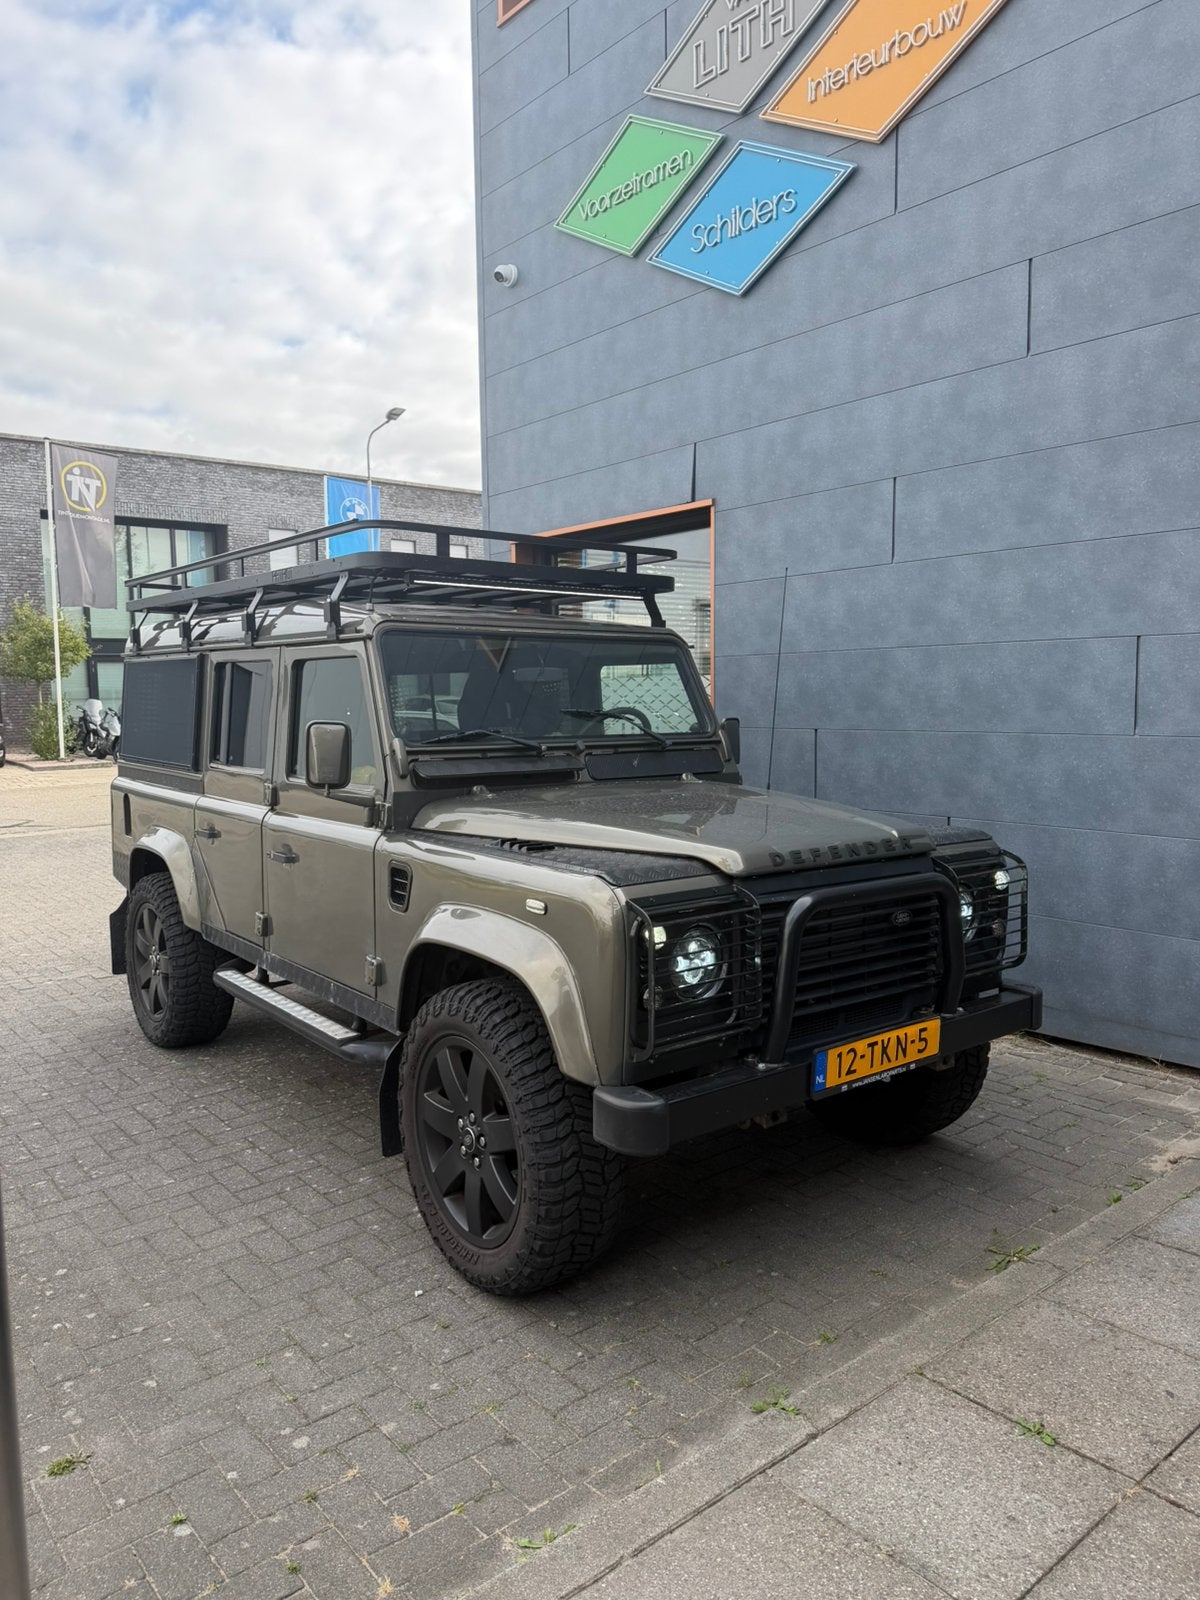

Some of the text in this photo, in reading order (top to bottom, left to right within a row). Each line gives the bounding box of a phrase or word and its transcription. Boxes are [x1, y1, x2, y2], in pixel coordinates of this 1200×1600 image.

[692, 0, 794, 89] LITH
[807, 0, 967, 104] Interieurbouw
[578, 148, 694, 221] Voorzetramen
[690, 188, 798, 253] Schilders
[768, 838, 913, 868] DEFENDER
[815, 1074, 826, 1085] NL
[836, 1026, 929, 1079] 12-TKN-5
